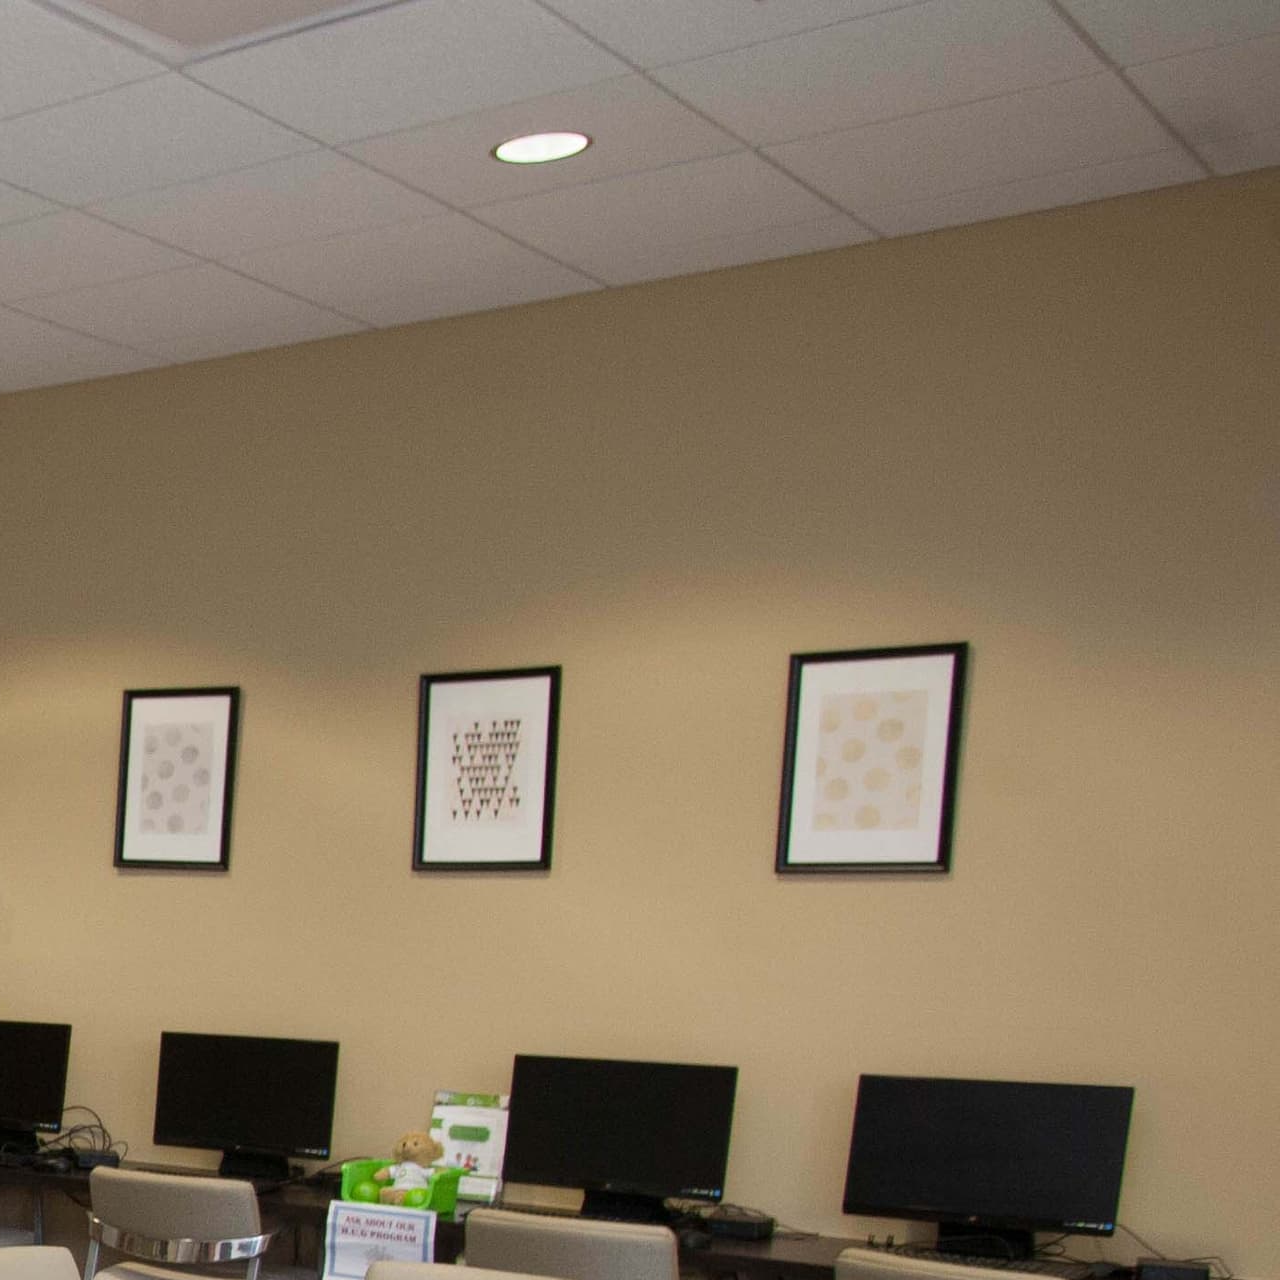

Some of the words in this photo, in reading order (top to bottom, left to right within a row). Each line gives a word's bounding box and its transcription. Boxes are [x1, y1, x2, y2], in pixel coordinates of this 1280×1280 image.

[344, 1215, 361, 1225] ASK
[365, 1217, 393, 1228] ABOUT
[395, 1221, 415, 1231] OUR
[368, 1230, 416, 1243] PROGRAM
